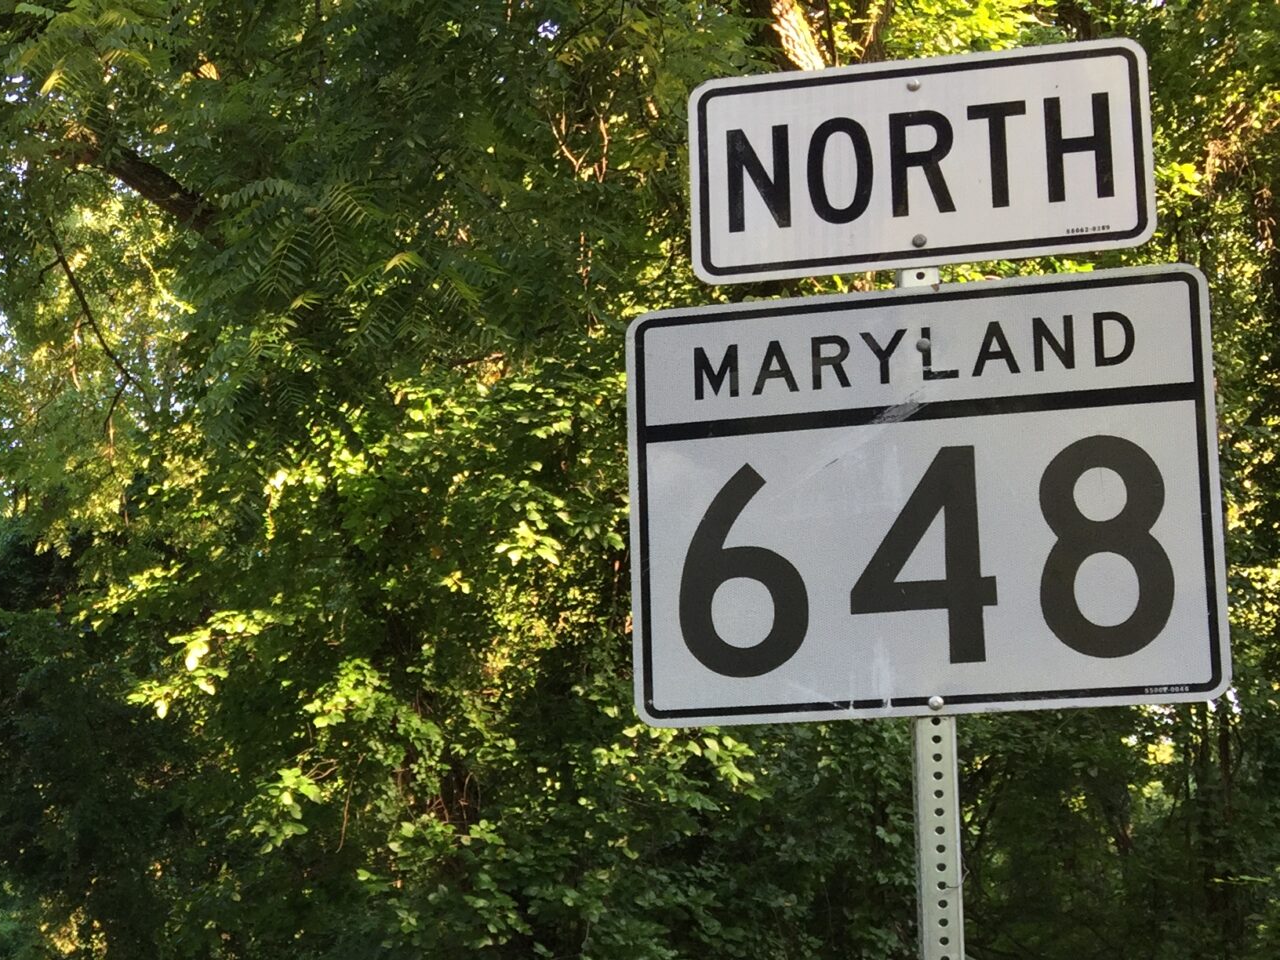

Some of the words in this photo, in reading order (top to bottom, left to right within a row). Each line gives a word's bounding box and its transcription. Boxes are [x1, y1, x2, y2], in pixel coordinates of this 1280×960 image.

[727, 92, 1114, 233] NORTH
[694, 311, 1136, 400] MARYLAND
[679, 435, 1175, 678] 648
